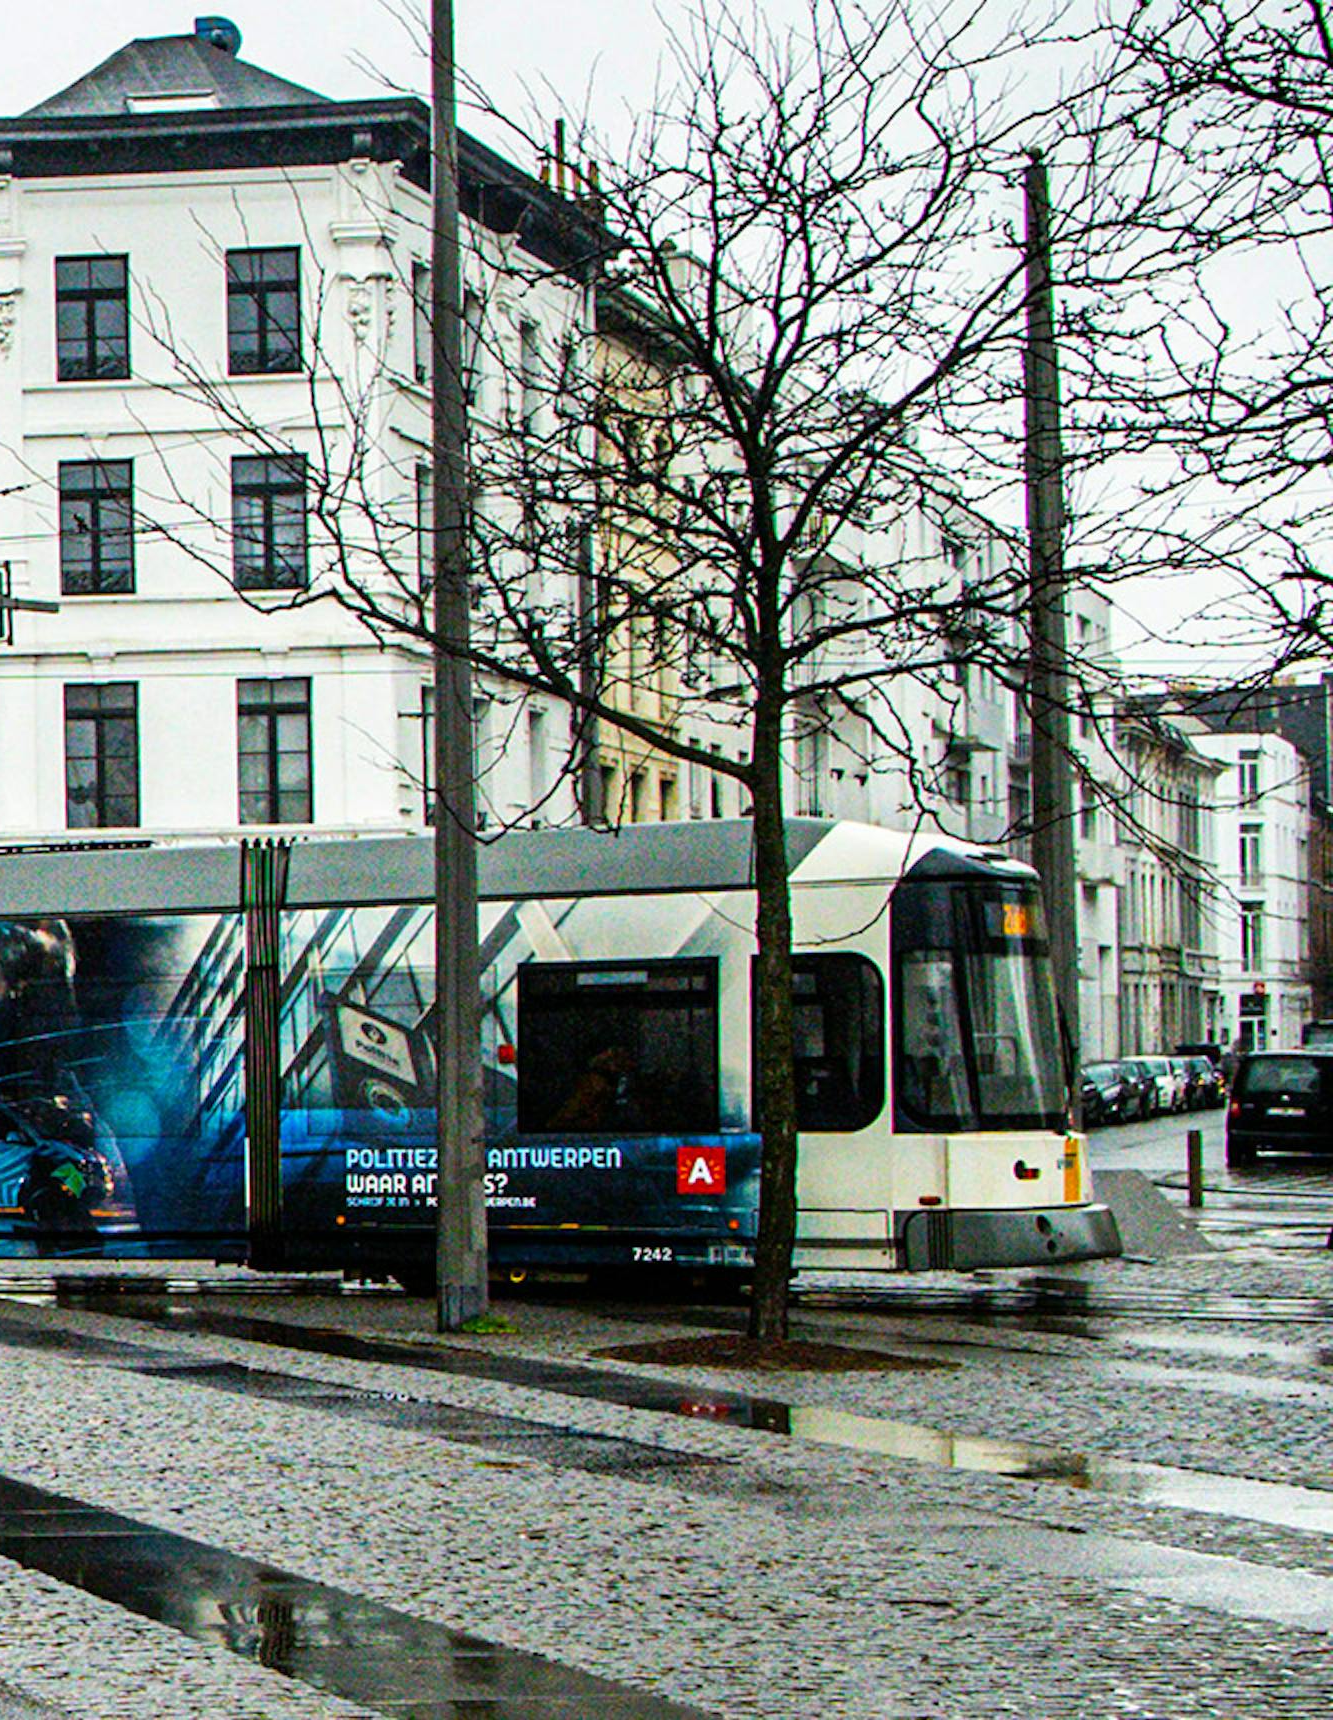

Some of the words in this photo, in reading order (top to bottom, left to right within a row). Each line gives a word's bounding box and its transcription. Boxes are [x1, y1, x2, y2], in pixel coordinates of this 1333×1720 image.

[345, 1148, 438, 1169] POLITIEZ
[487, 1147, 623, 1169] ANTWERPEN
[345, 1173, 407, 1193] WAAR
[411, 1173, 509, 1194] ANS?
[632, 1246, 673, 1261] 7242
